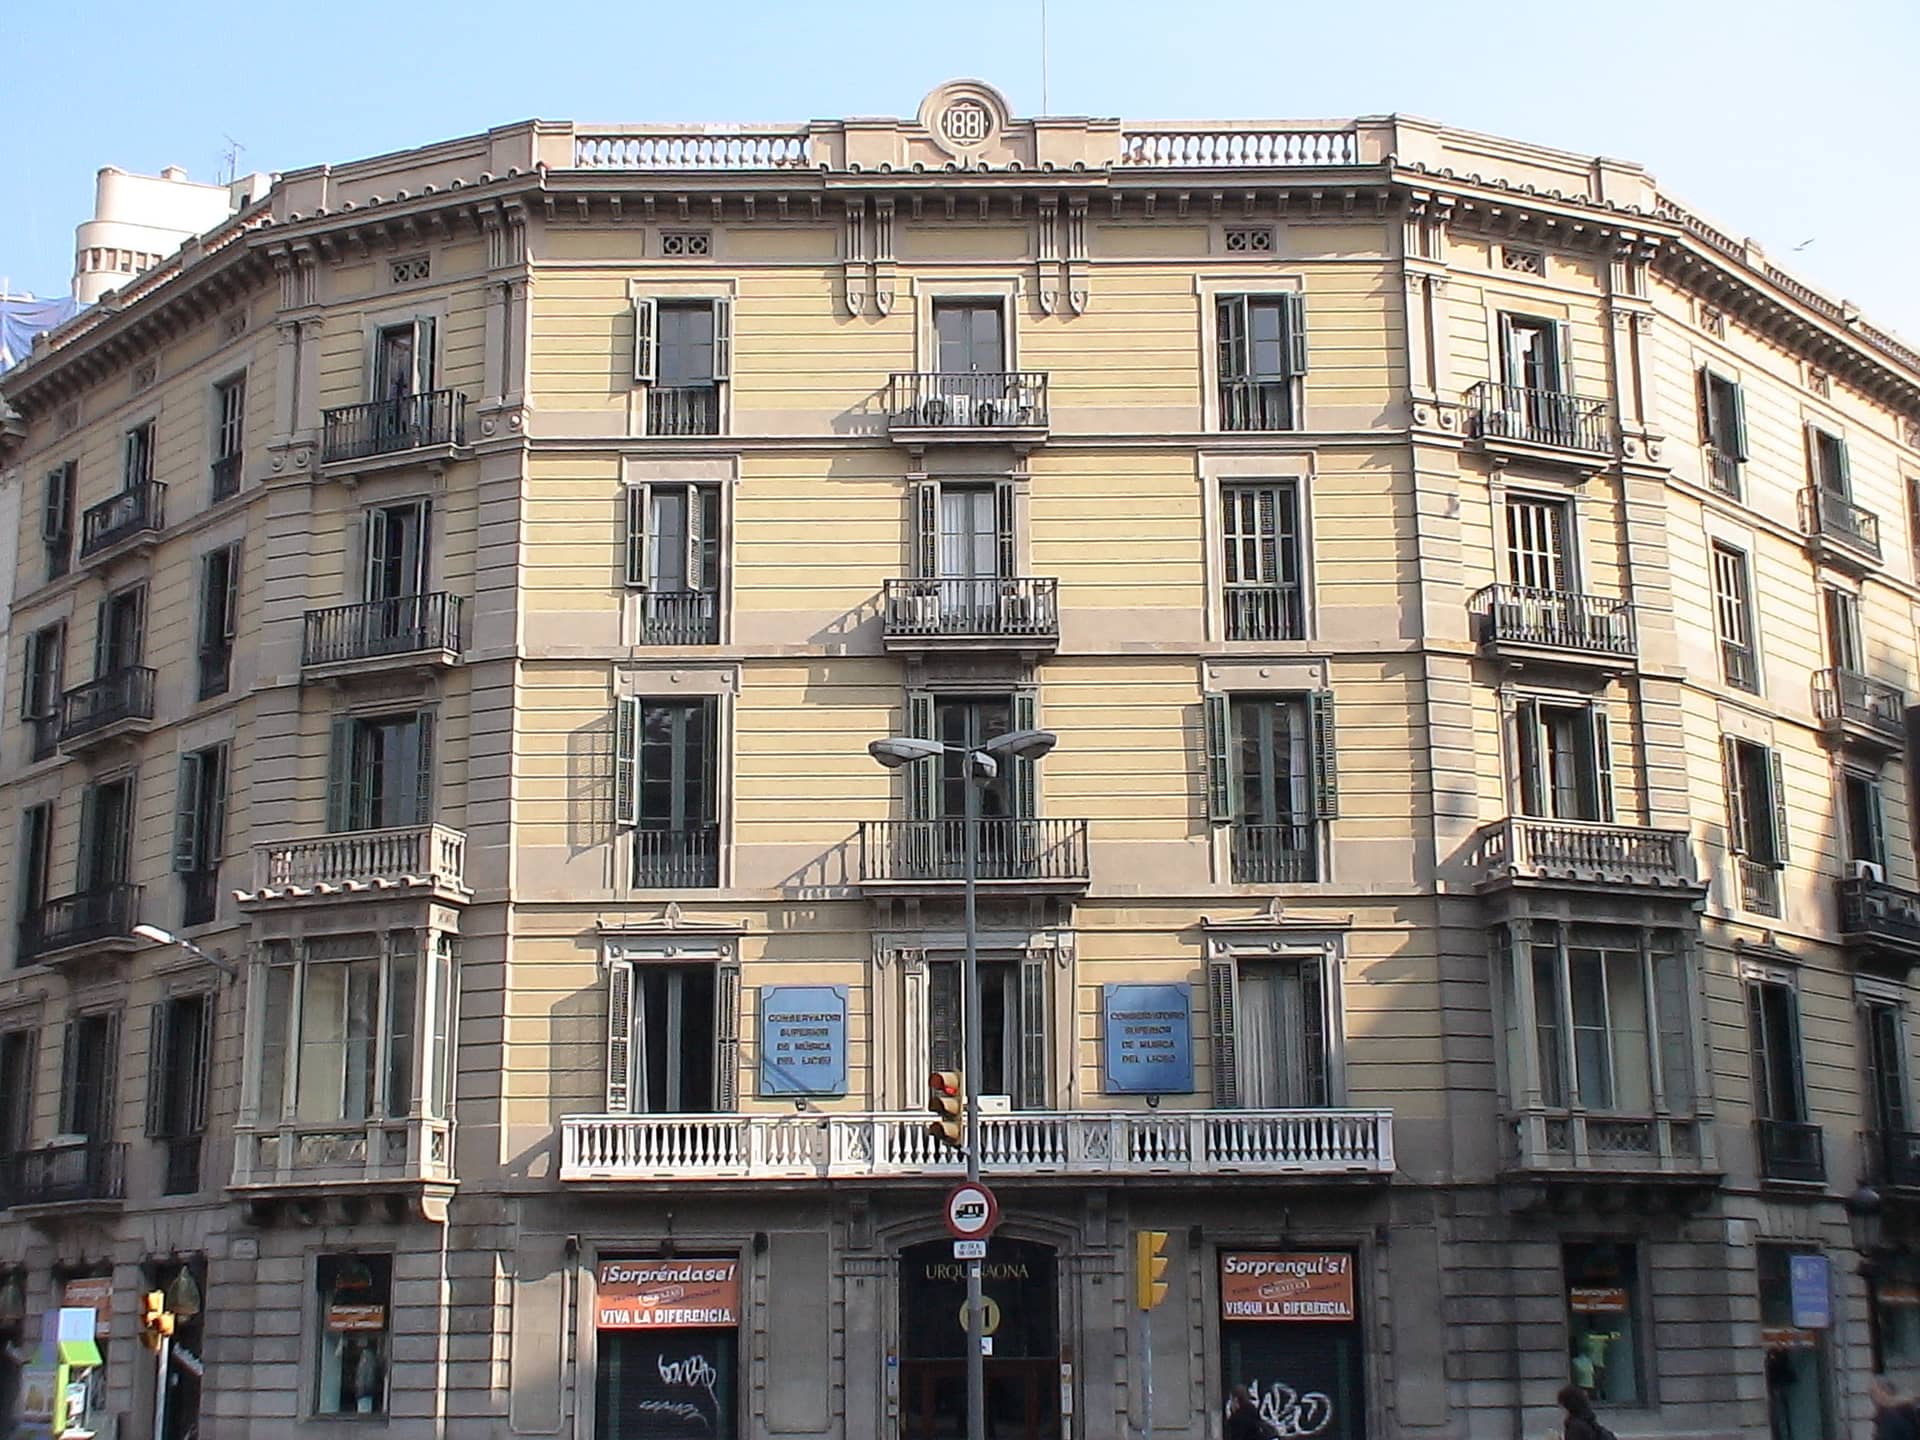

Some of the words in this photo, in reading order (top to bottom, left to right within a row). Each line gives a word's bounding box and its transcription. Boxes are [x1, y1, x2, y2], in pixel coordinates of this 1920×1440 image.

[947, 110, 985, 138] 1881
[601, 1264, 736, 1285] ¡Sorpréndase!
[600, 1309, 631, 1323] VIVA
[633, 1309, 651, 1323] LA
[1265, 1301, 1280, 1315] LA
